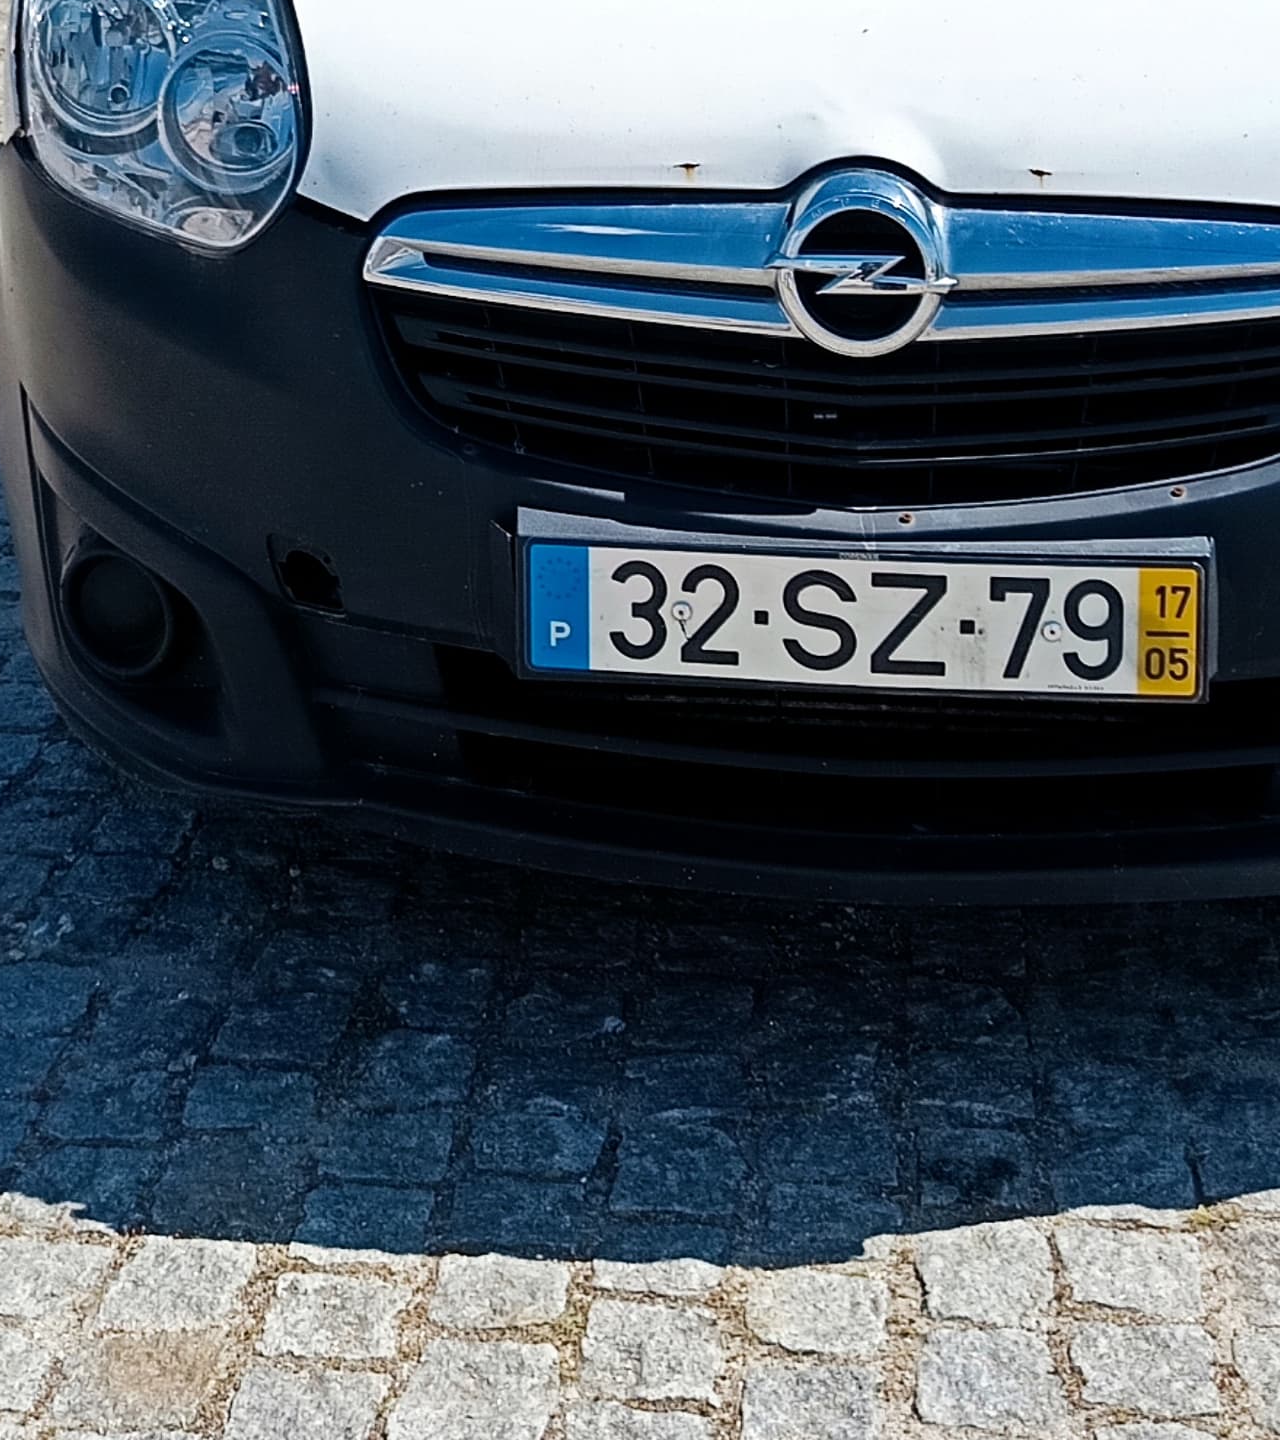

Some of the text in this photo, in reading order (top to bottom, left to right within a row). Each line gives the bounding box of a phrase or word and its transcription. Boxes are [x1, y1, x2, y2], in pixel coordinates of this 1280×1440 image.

[1154, 585, 1192, 620] 17
[549, 620, 571, 647] P
[1144, 648, 1190, 681] 05
